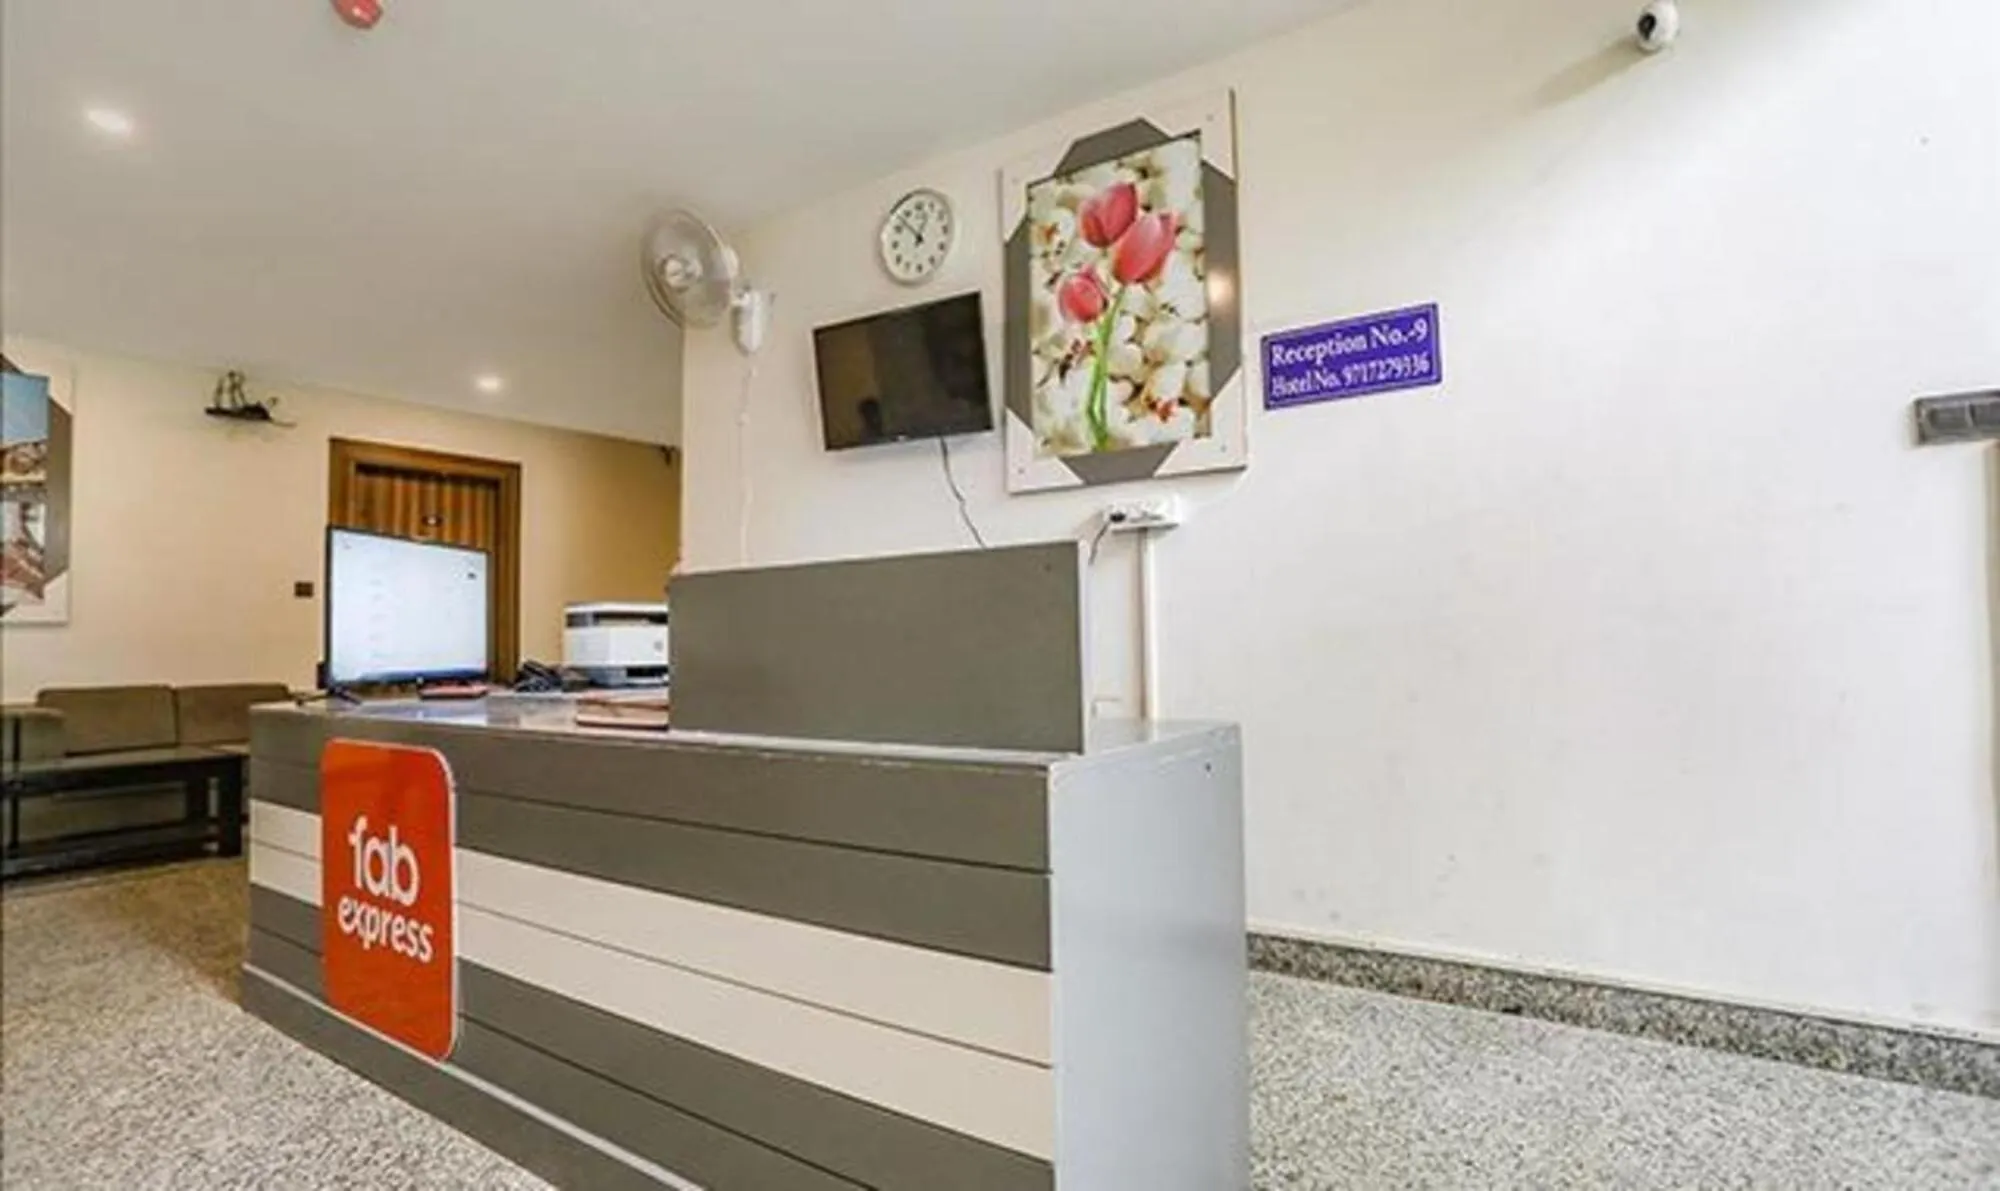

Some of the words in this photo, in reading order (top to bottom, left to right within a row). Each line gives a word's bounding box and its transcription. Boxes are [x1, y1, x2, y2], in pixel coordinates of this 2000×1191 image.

[1271, 331, 1368, 367] Reception
[348, 815, 420, 907] fab
[337, 895, 435, 964] express
